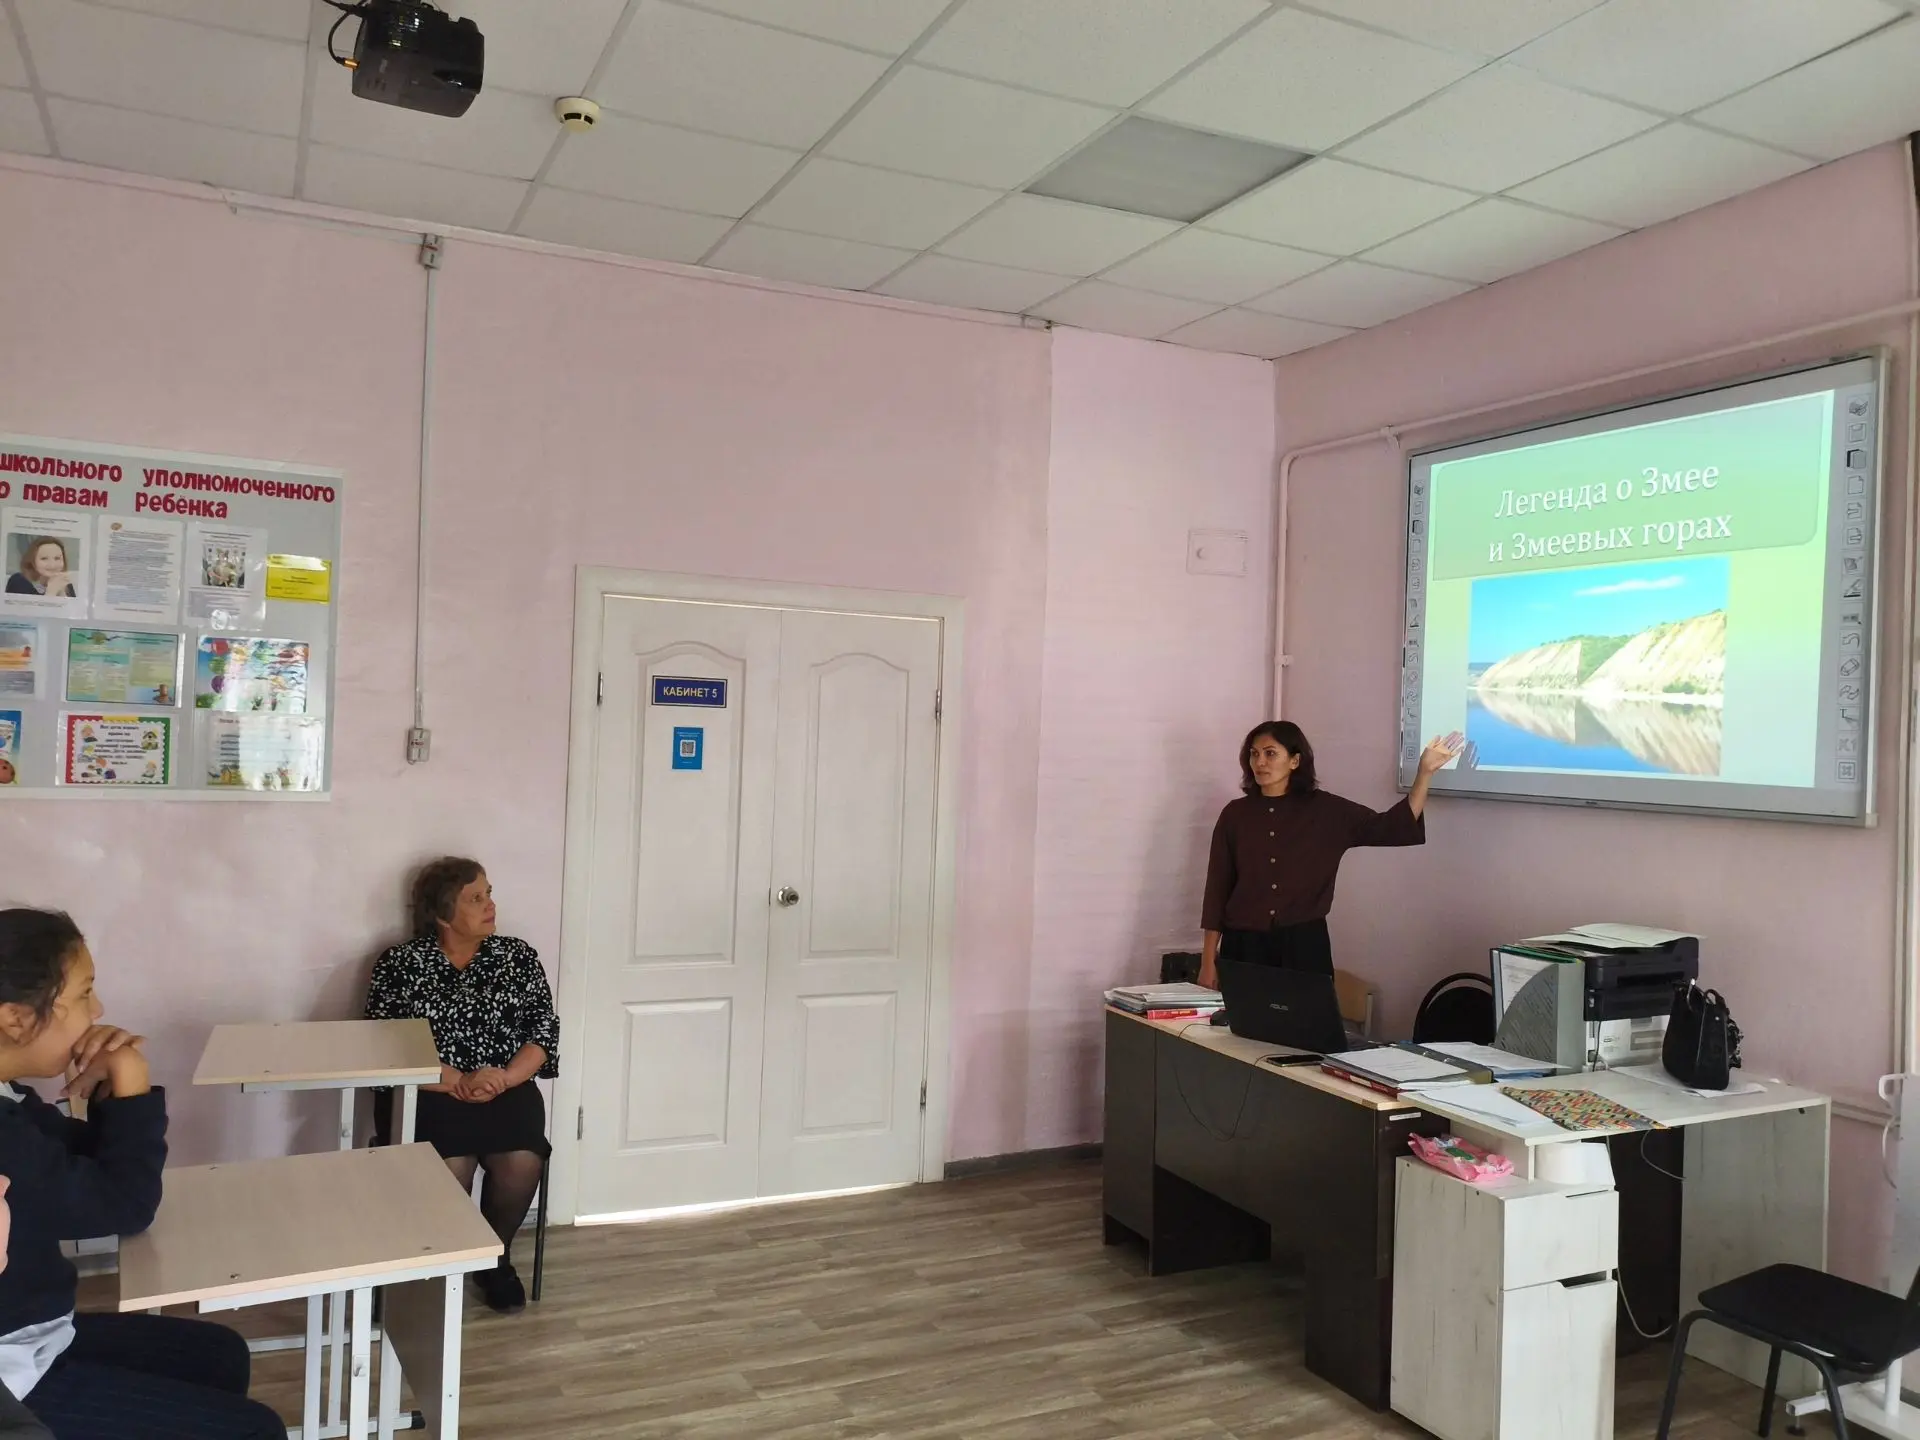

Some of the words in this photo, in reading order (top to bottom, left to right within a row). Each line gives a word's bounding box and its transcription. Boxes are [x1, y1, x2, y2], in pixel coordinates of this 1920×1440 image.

[0, 453, 123, 483] школьного
[142, 468, 336, 503] уполномоченного
[22, 483, 109, 508] правам
[135, 491, 229, 519] ребёнка
[1494, 481, 1609, 518] Легенда
[1616, 478, 1634, 501] о
[1640, 465, 1720, 497] Змее
[1487, 540, 1504, 563] и
[1510, 526, 1634, 561] Змеевых
[1641, 513, 1734, 551] горах
[663, 686, 710, 698] КАБИНЕТ
[712, 688, 718, 698] 5
